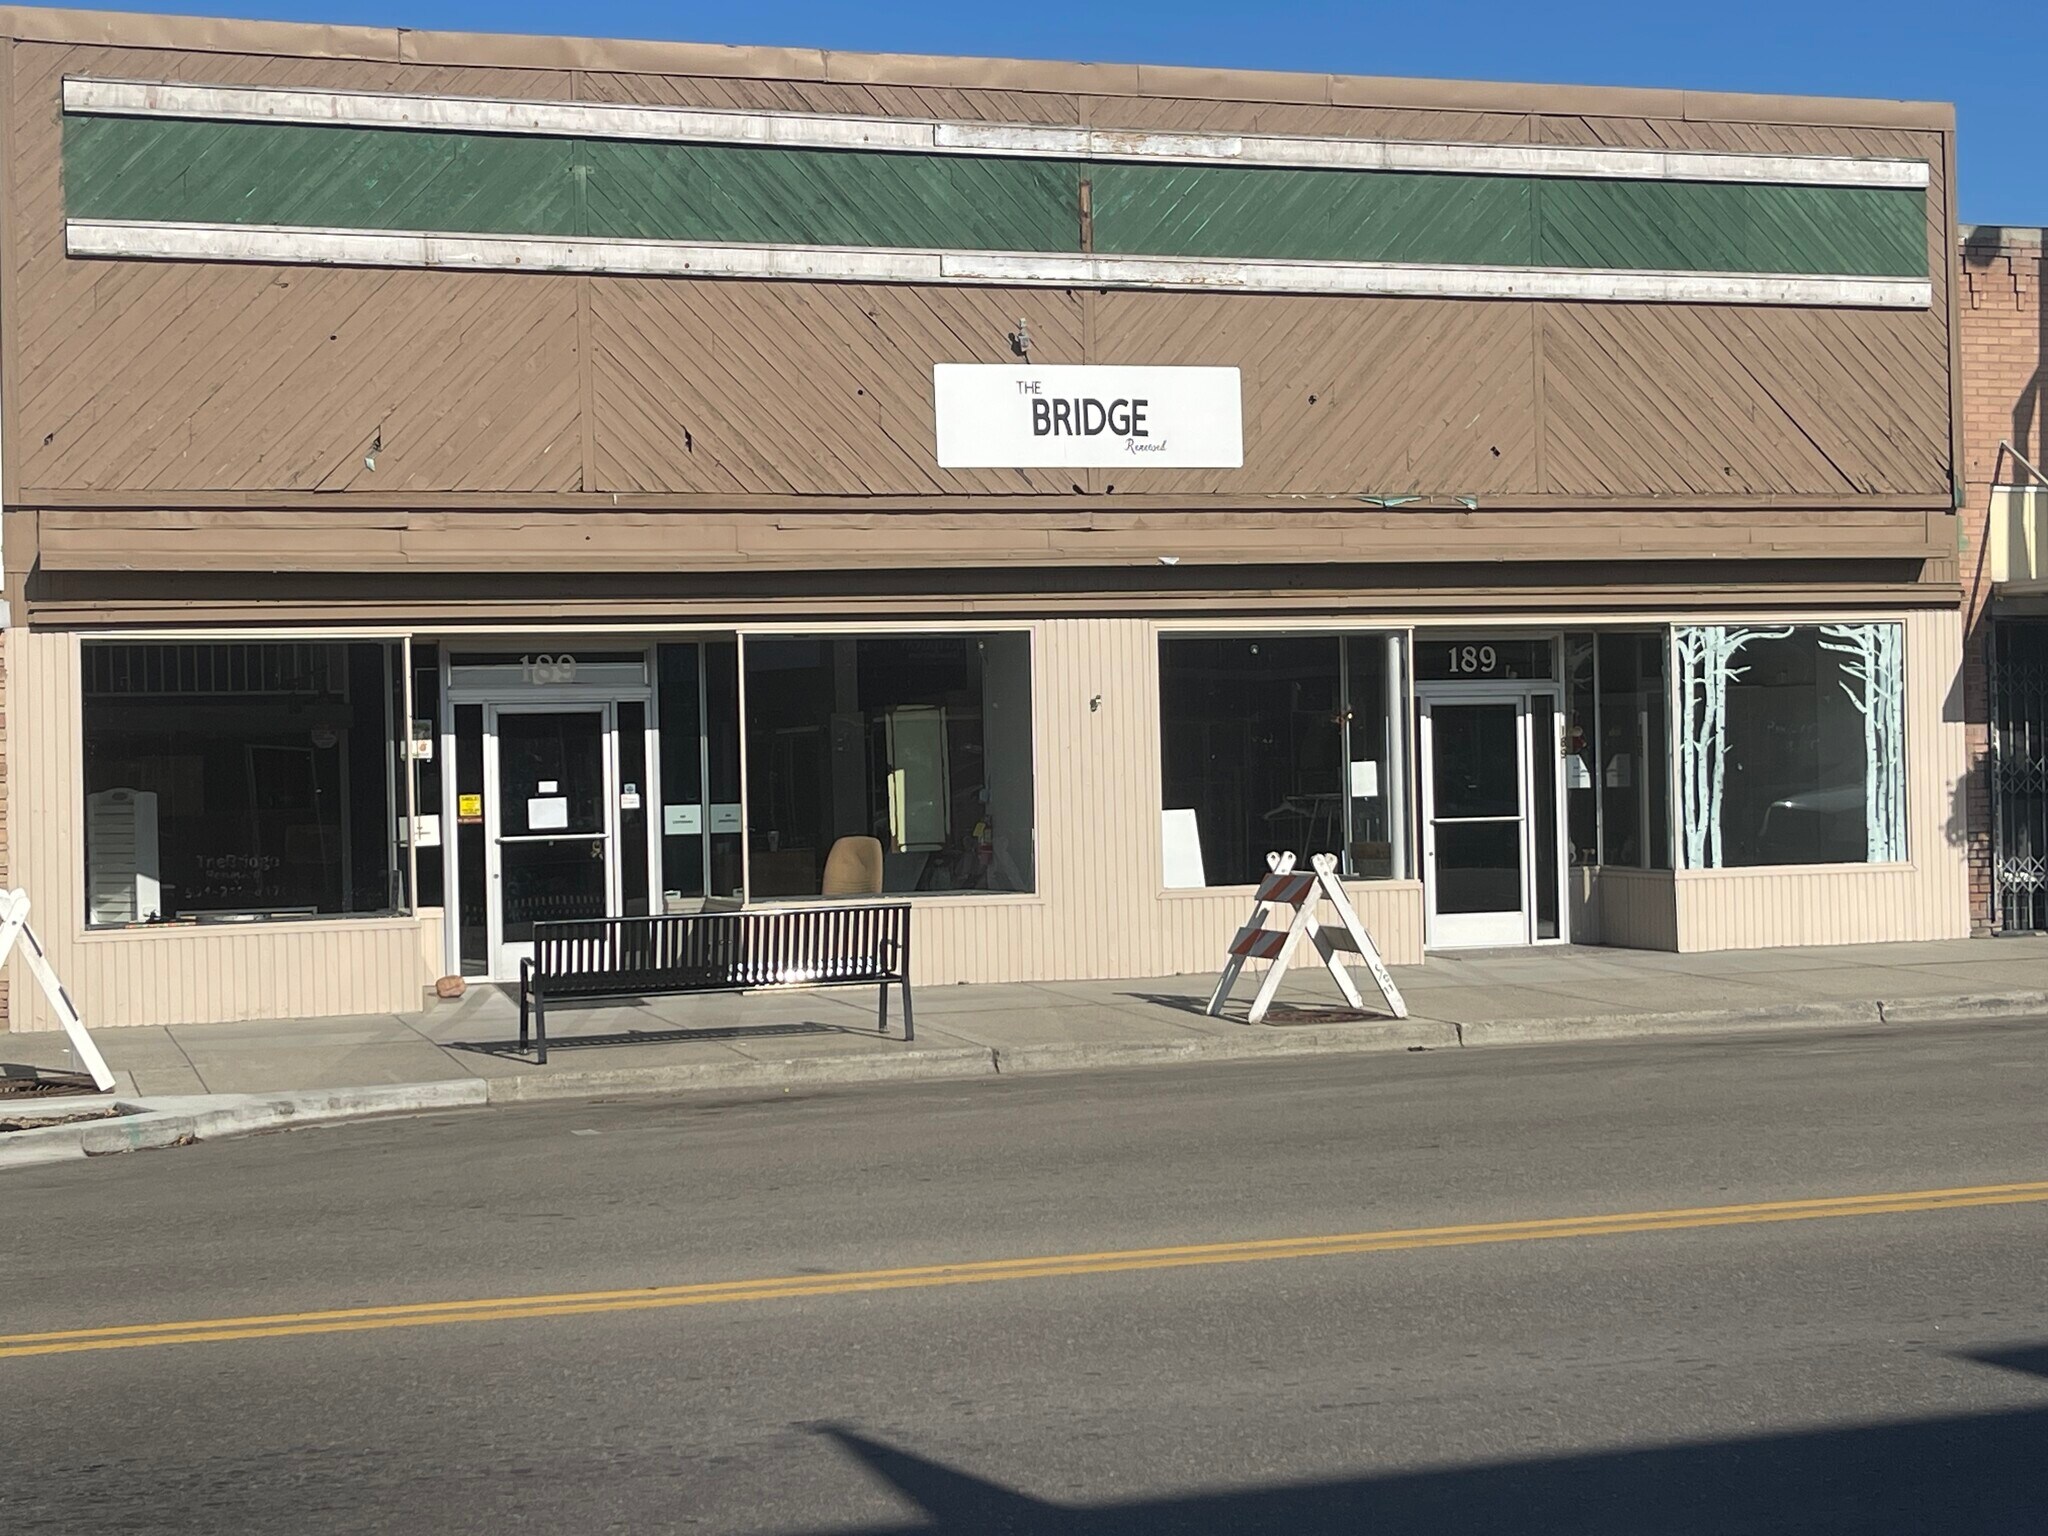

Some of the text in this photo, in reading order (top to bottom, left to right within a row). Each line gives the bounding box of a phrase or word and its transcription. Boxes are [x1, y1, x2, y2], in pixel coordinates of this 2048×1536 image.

[1016, 380, 1042, 395] THE
[1032, 398, 1149, 437] BRIDGE
[519, 654, 577, 684] 189
[1448, 645, 1497, 672] 189
